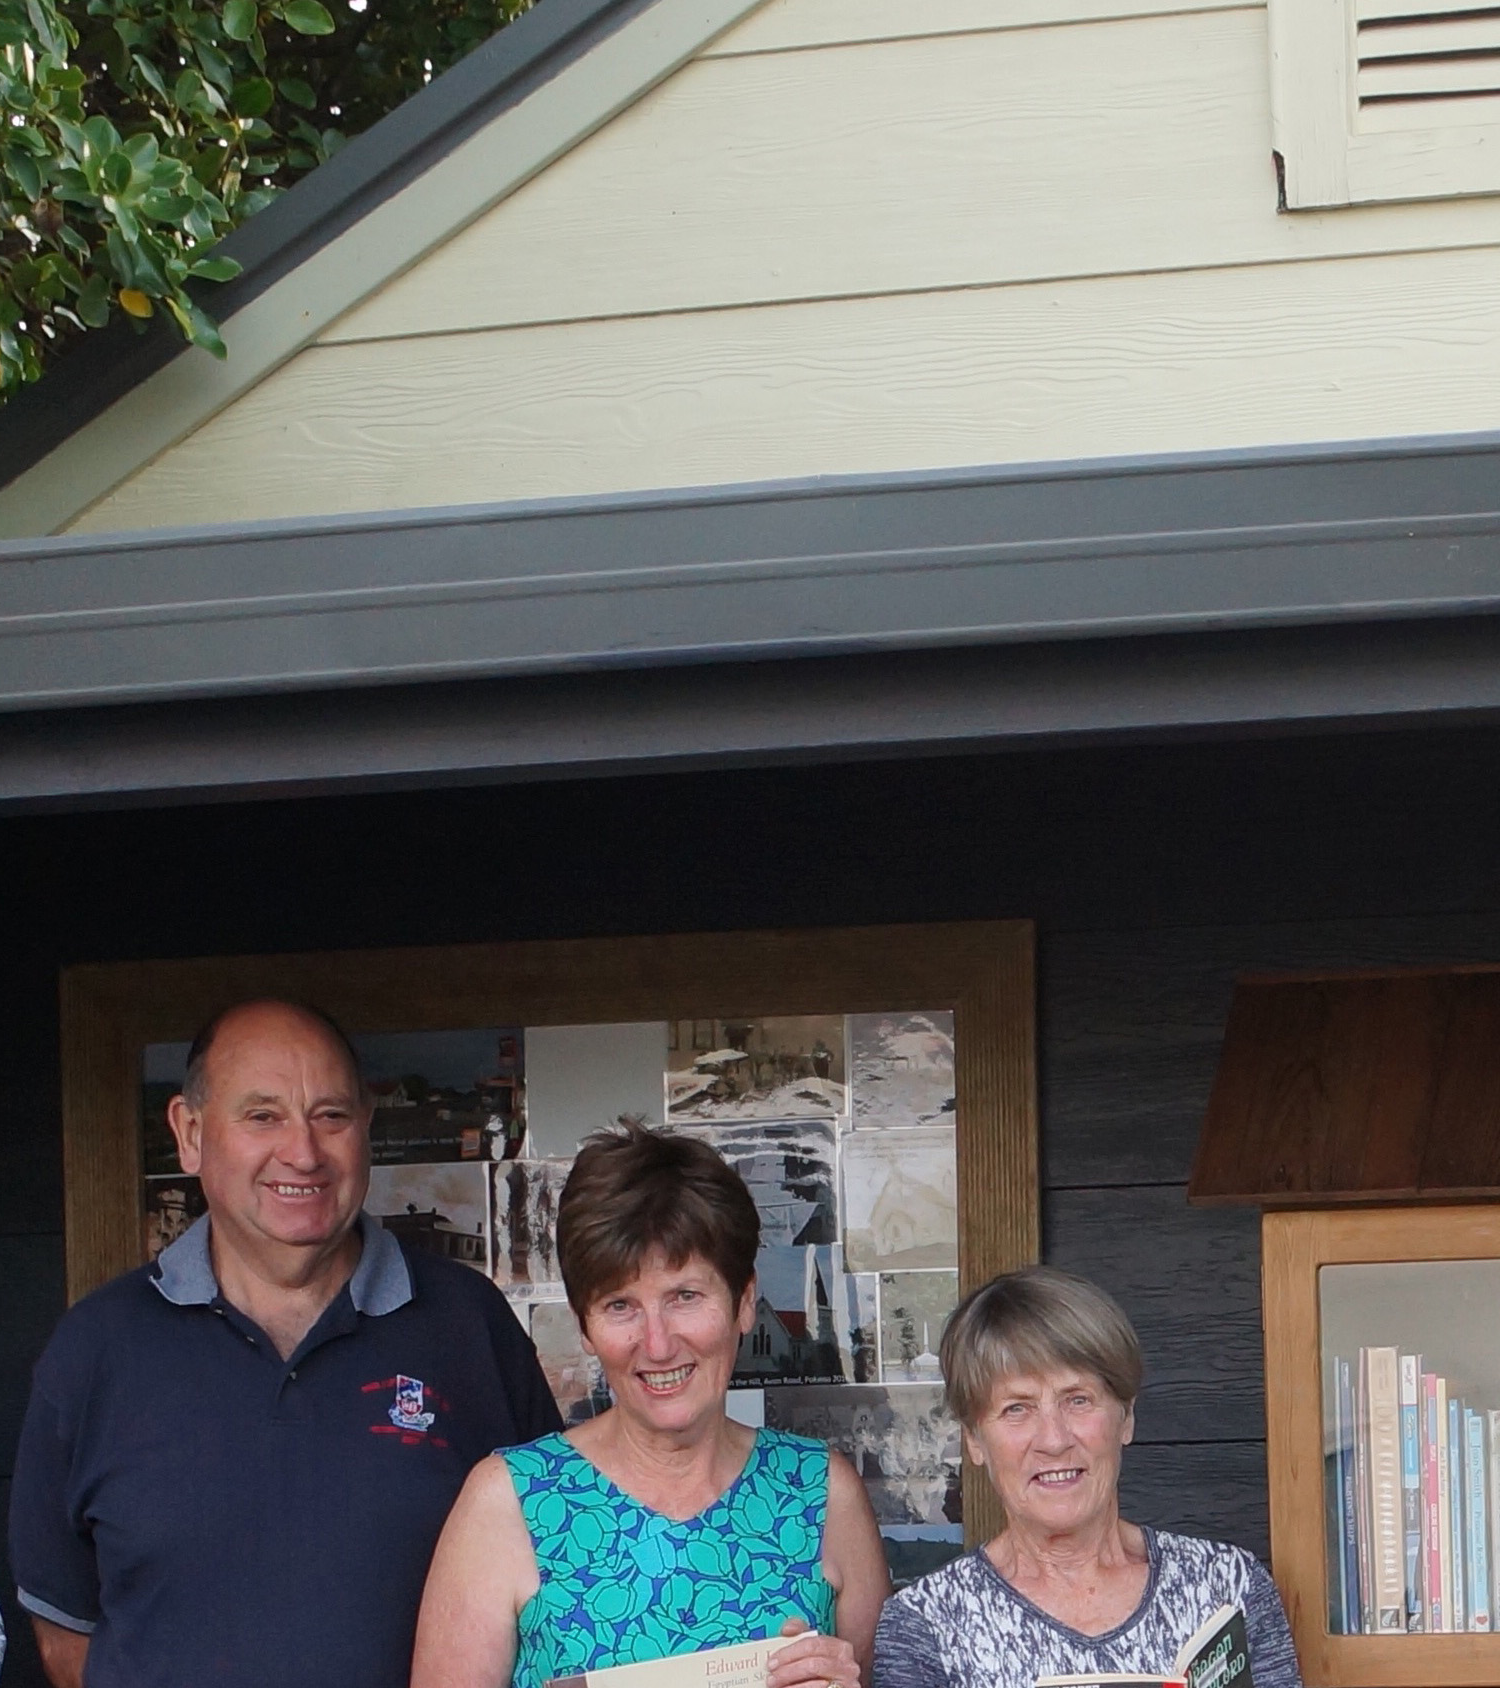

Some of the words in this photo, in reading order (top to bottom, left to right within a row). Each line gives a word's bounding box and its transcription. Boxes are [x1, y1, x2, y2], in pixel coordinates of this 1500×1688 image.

[1472, 1445, 1481, 1467] Joan
[1473, 1468, 1482, 1498] Smith
[705, 1652, 759, 1677] Edward
